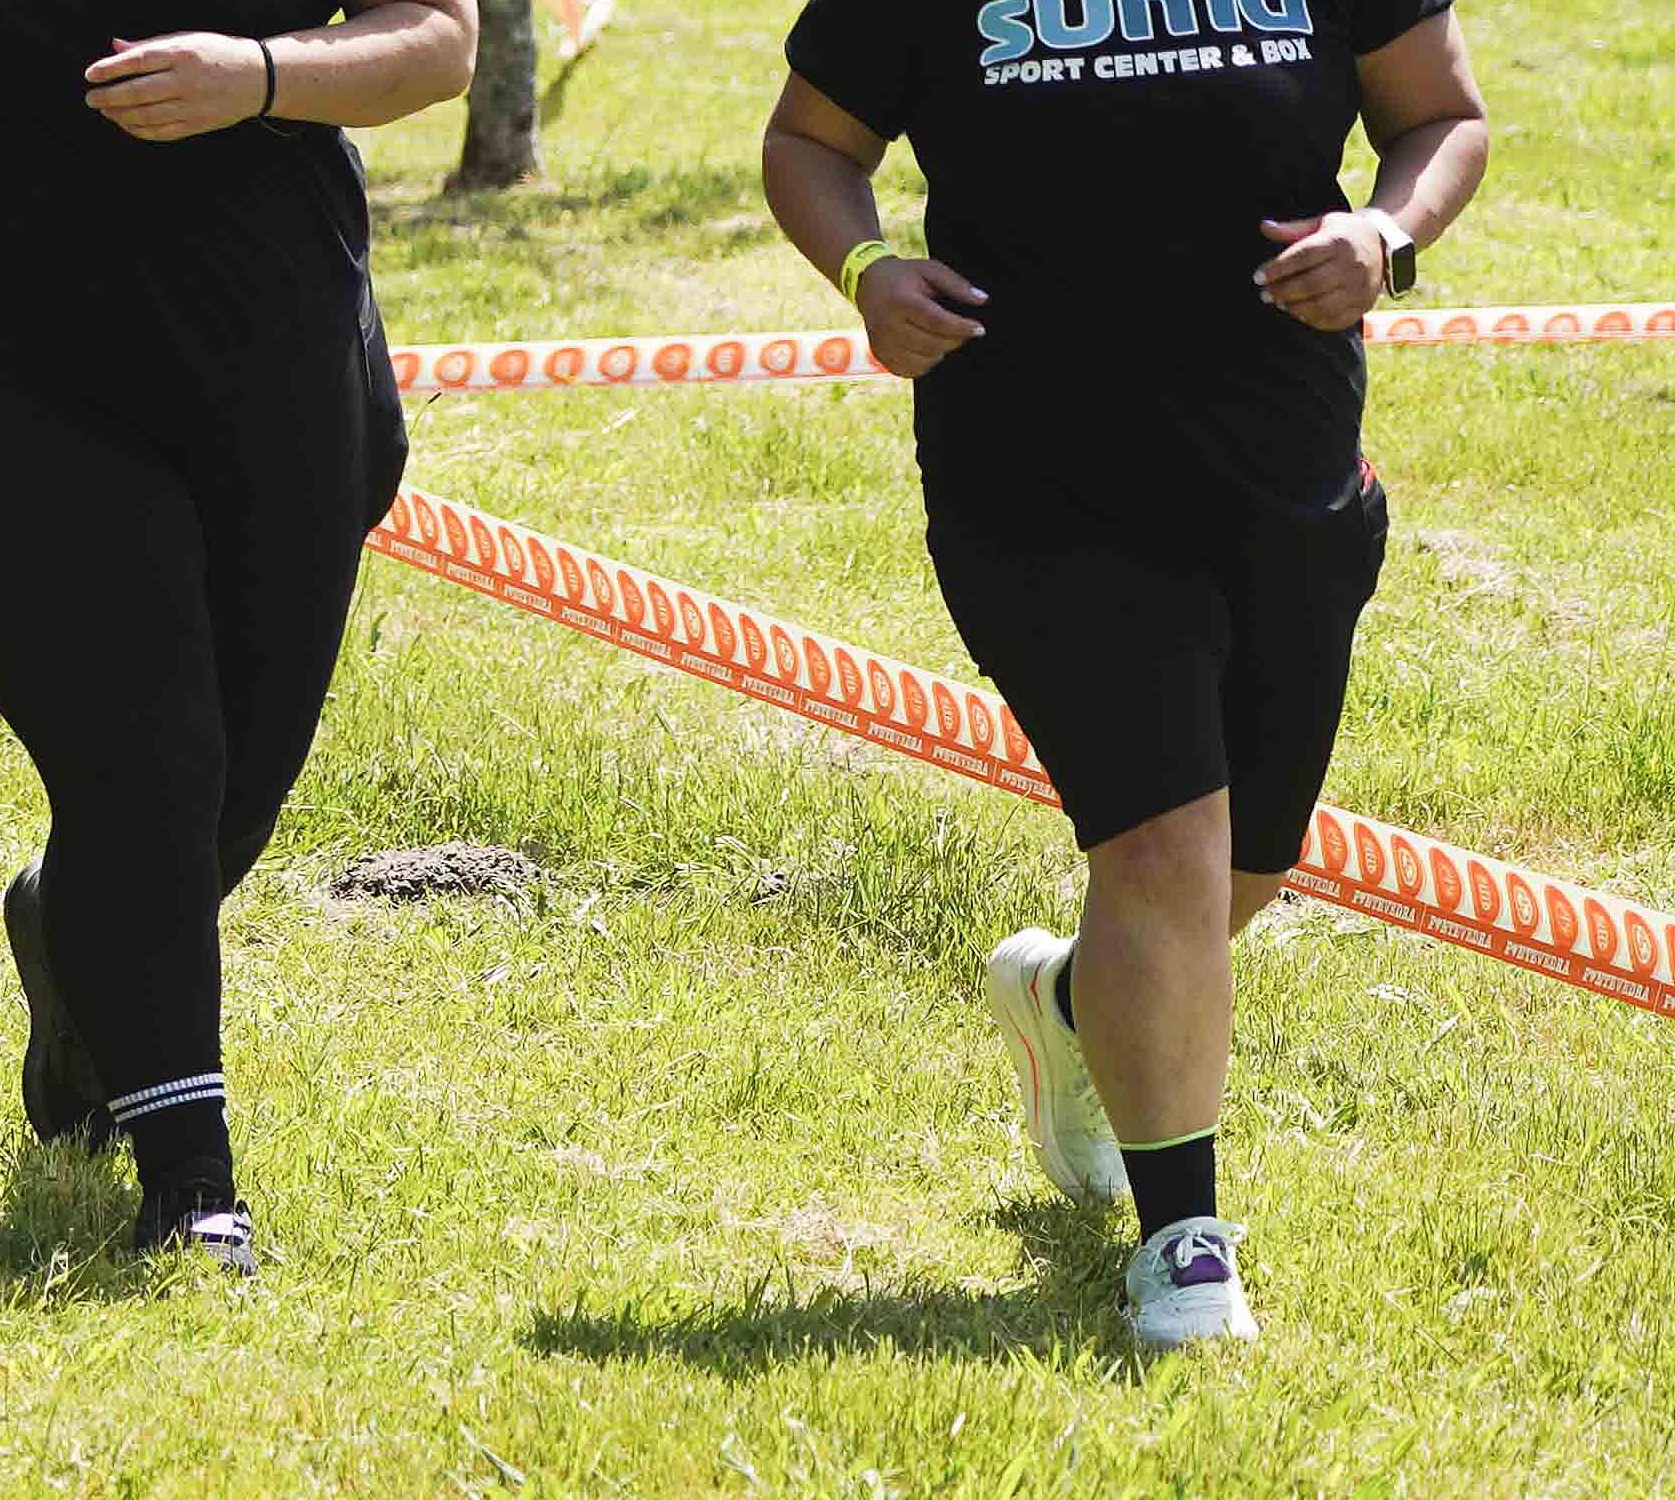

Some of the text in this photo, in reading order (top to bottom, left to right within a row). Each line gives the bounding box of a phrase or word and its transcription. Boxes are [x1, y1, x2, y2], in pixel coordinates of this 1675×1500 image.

[983, 36, 1313, 87] SPORT CENTER & BOX
